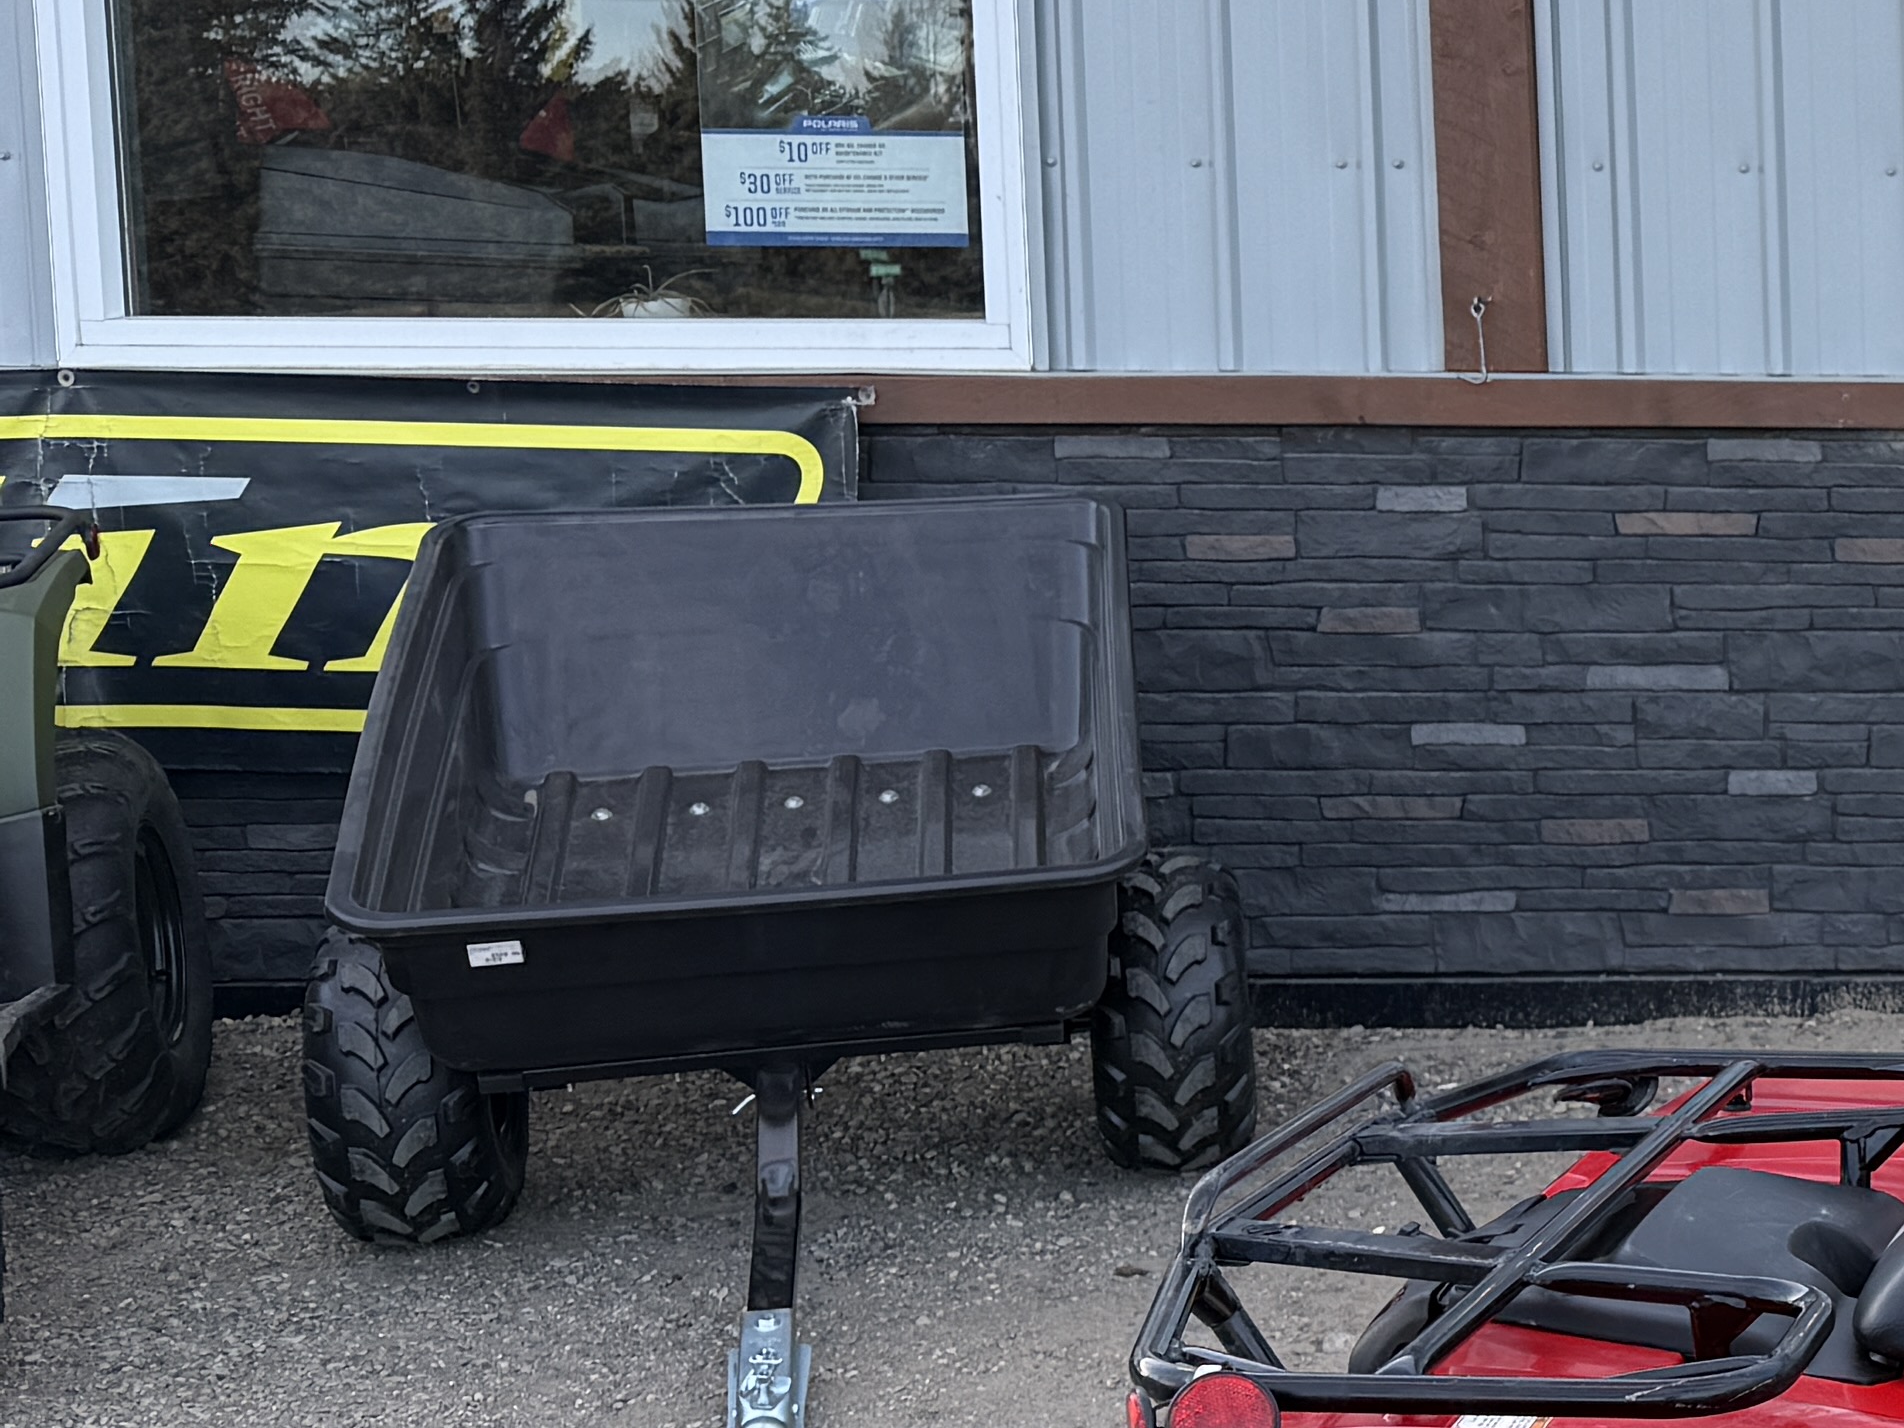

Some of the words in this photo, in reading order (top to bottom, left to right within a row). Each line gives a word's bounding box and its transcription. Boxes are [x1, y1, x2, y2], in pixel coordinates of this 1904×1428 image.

[779, 140, 809, 164] $10
[811, 141, 832, 156] OFF
[739, 171, 772, 195] $30
[774, 173, 795, 186] OFF
[724, 204, 768, 228] $100
[770, 206, 791, 221] OFF
